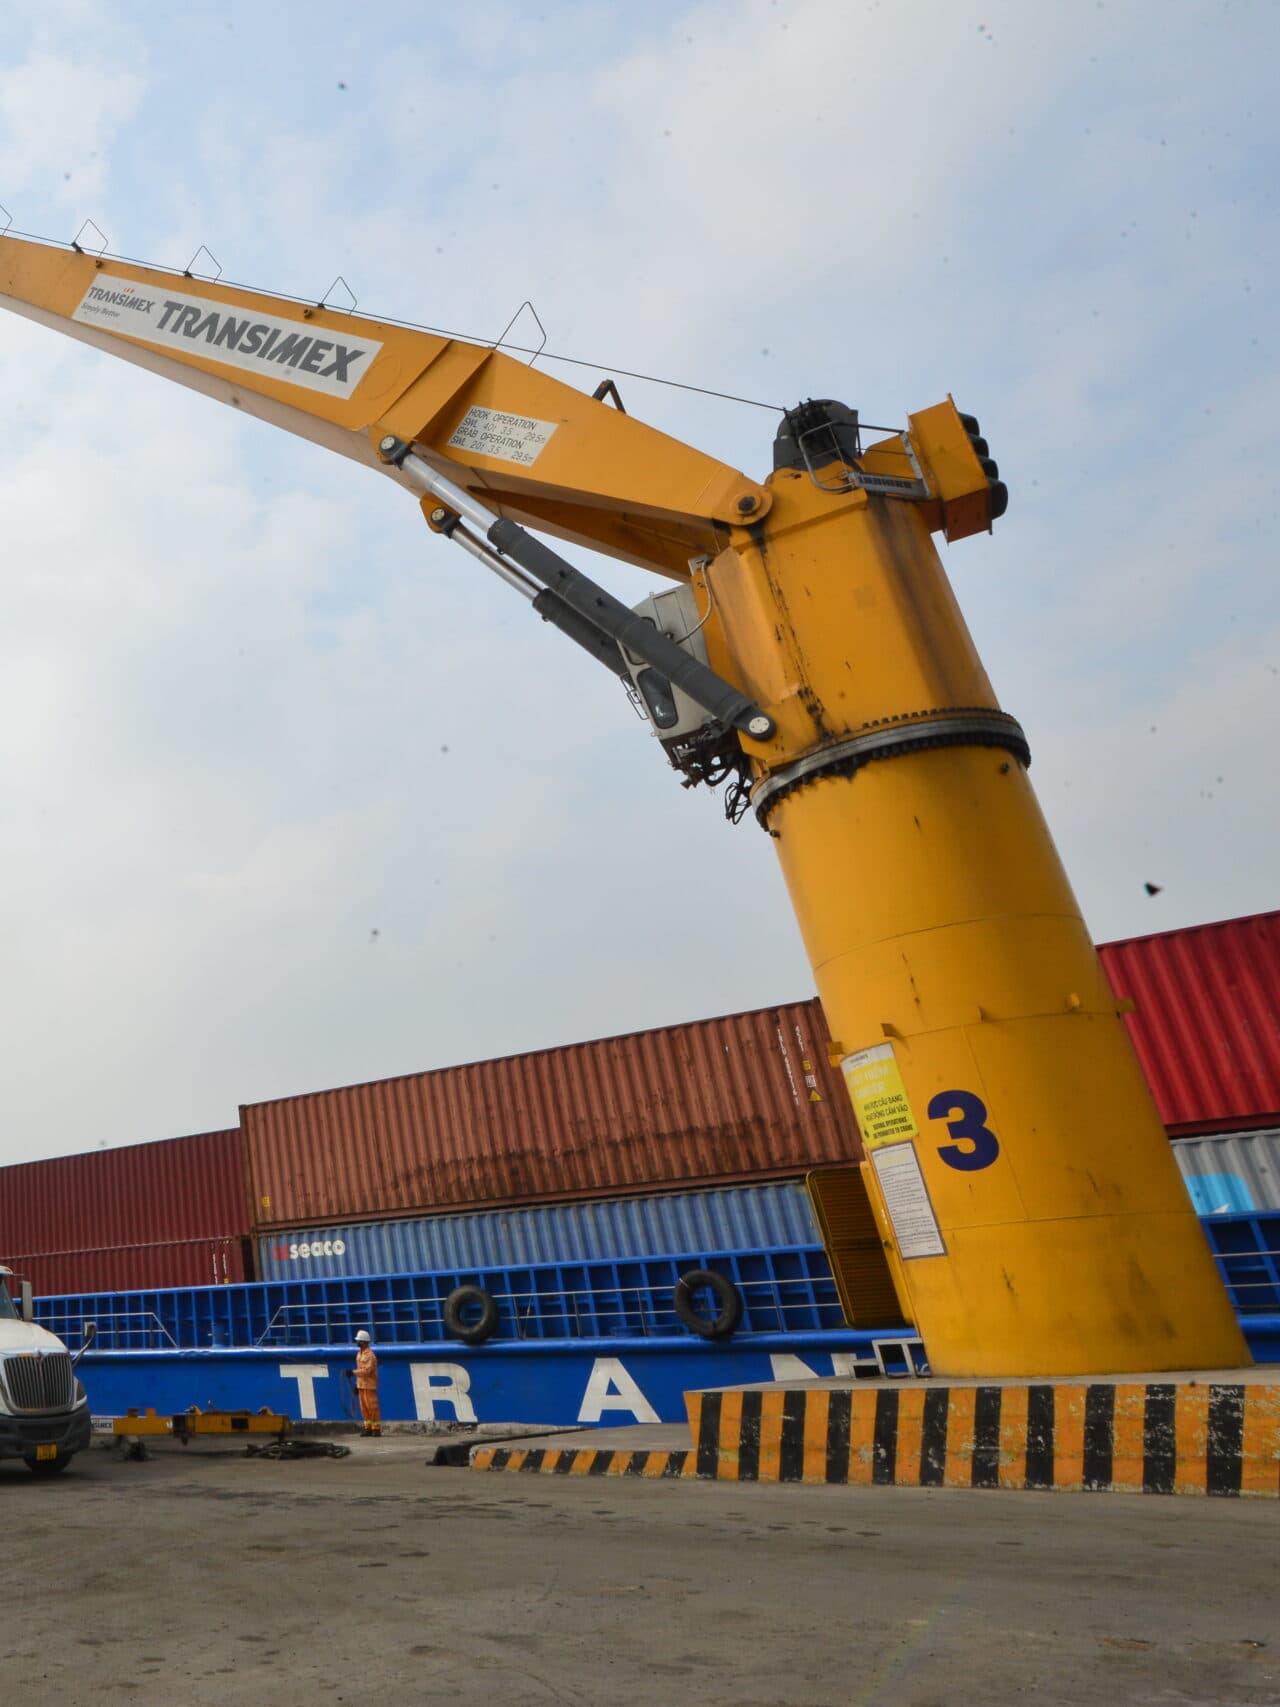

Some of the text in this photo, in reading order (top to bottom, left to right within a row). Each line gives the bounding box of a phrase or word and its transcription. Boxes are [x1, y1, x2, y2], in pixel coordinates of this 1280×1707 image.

[87, 286, 156, 314] TRANSIMEX
[156, 300, 366, 383] TRANSIMEX
[463, 417, 478, 428] SWL
[468, 408, 537, 430] HOOK OPERATION
[450, 435, 466, 447] SWL
[457, 427, 525, 449] GRAB OPERATION
[927, 1089, 1000, 1172] 3
[289, 1239, 346, 1260] seaco
